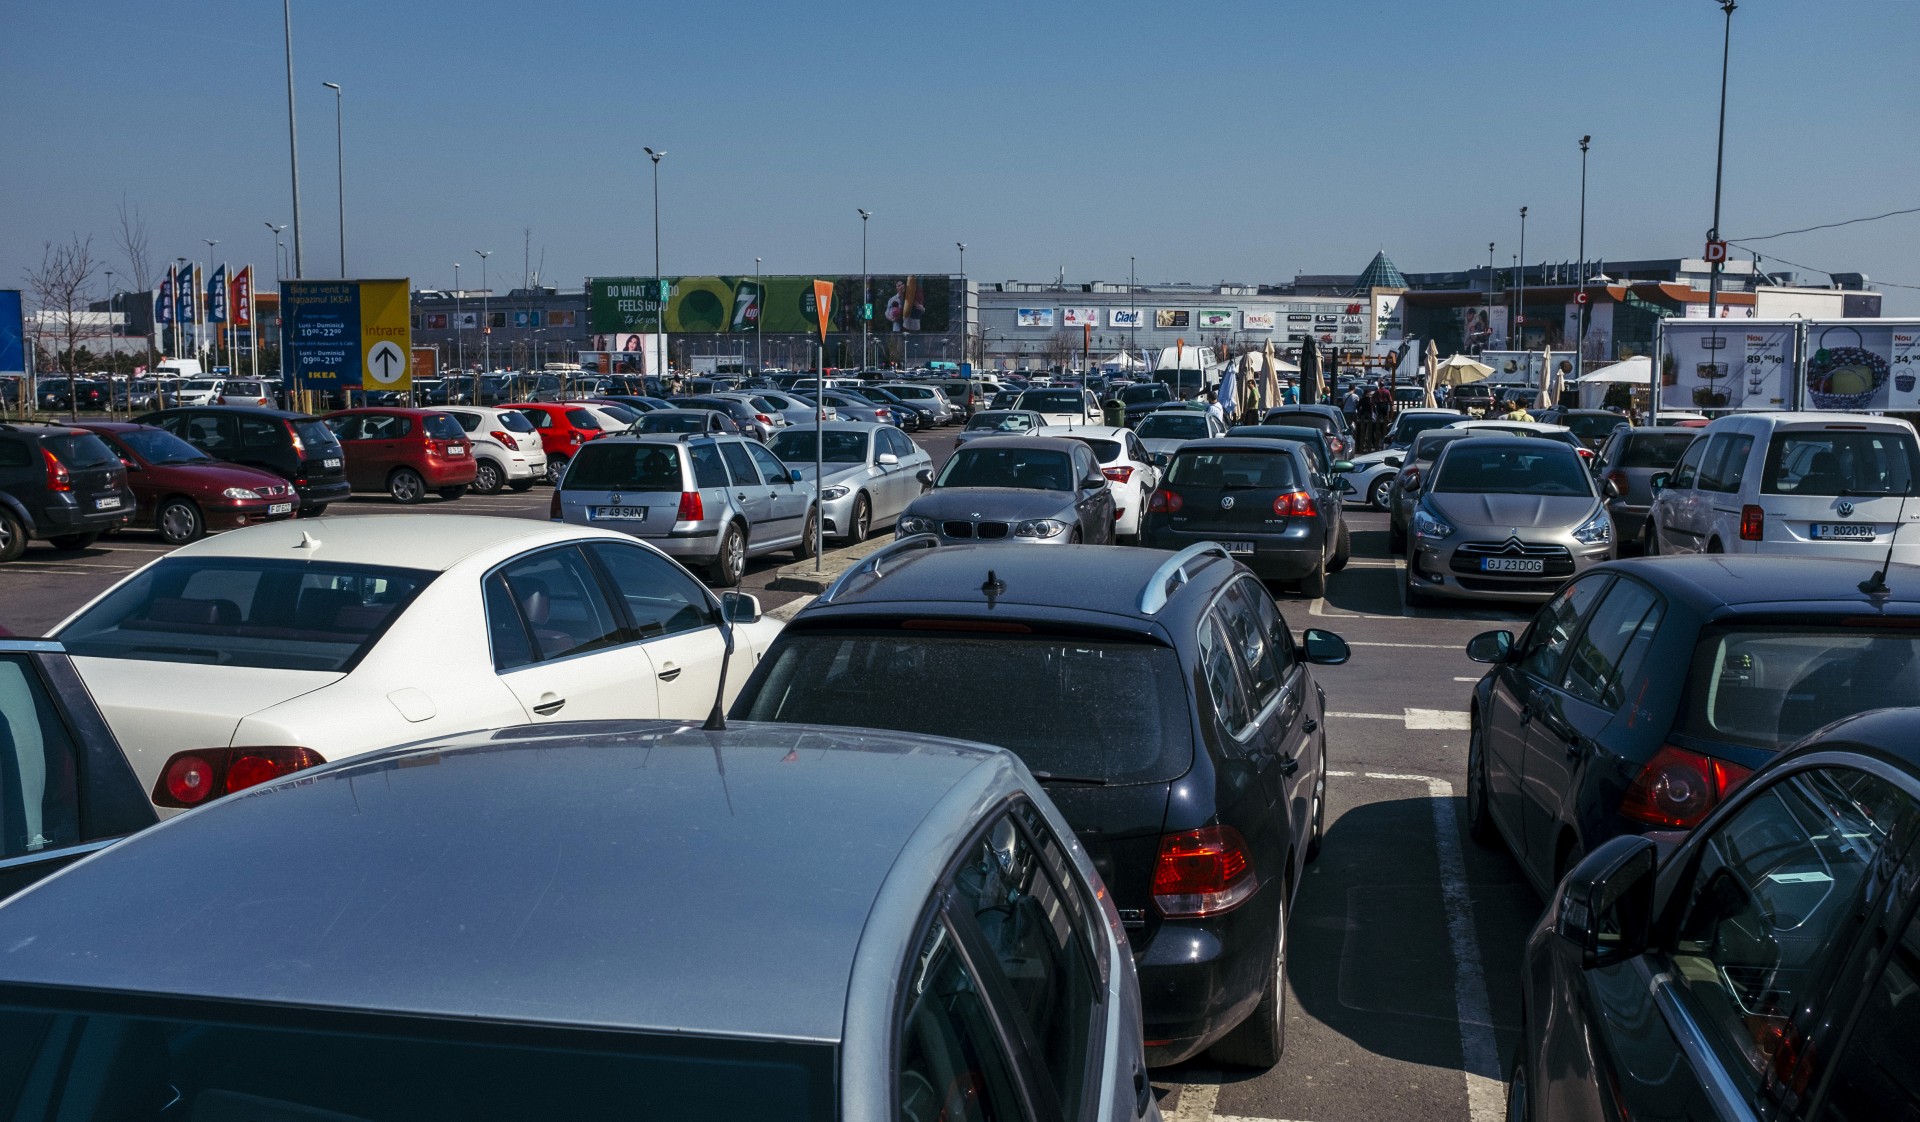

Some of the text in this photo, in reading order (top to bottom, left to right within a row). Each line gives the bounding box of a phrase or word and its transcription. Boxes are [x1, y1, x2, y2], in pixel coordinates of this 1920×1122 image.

[1708, 245, 1724, 260] D
[291, 285, 349, 294] Bine ai venit la
[607, 285, 618, 297] DO
[621, 285, 646, 297] WHAT
[288, 295, 352, 304] magazinul IKEA!
[1577, 294, 1585, 303] C
[618, 300, 643, 312] FEELS
[365, 325, 405, 337] intrare
[308, 371, 337, 379] IKEA
[597, 508, 642, 517] IF 49 SAN
[1822, 526, 1873, 536] P 8020 BX
[1235, 544, 1249, 552] ALI
[1488, 559, 1542, 571] GJ 23 DOG
